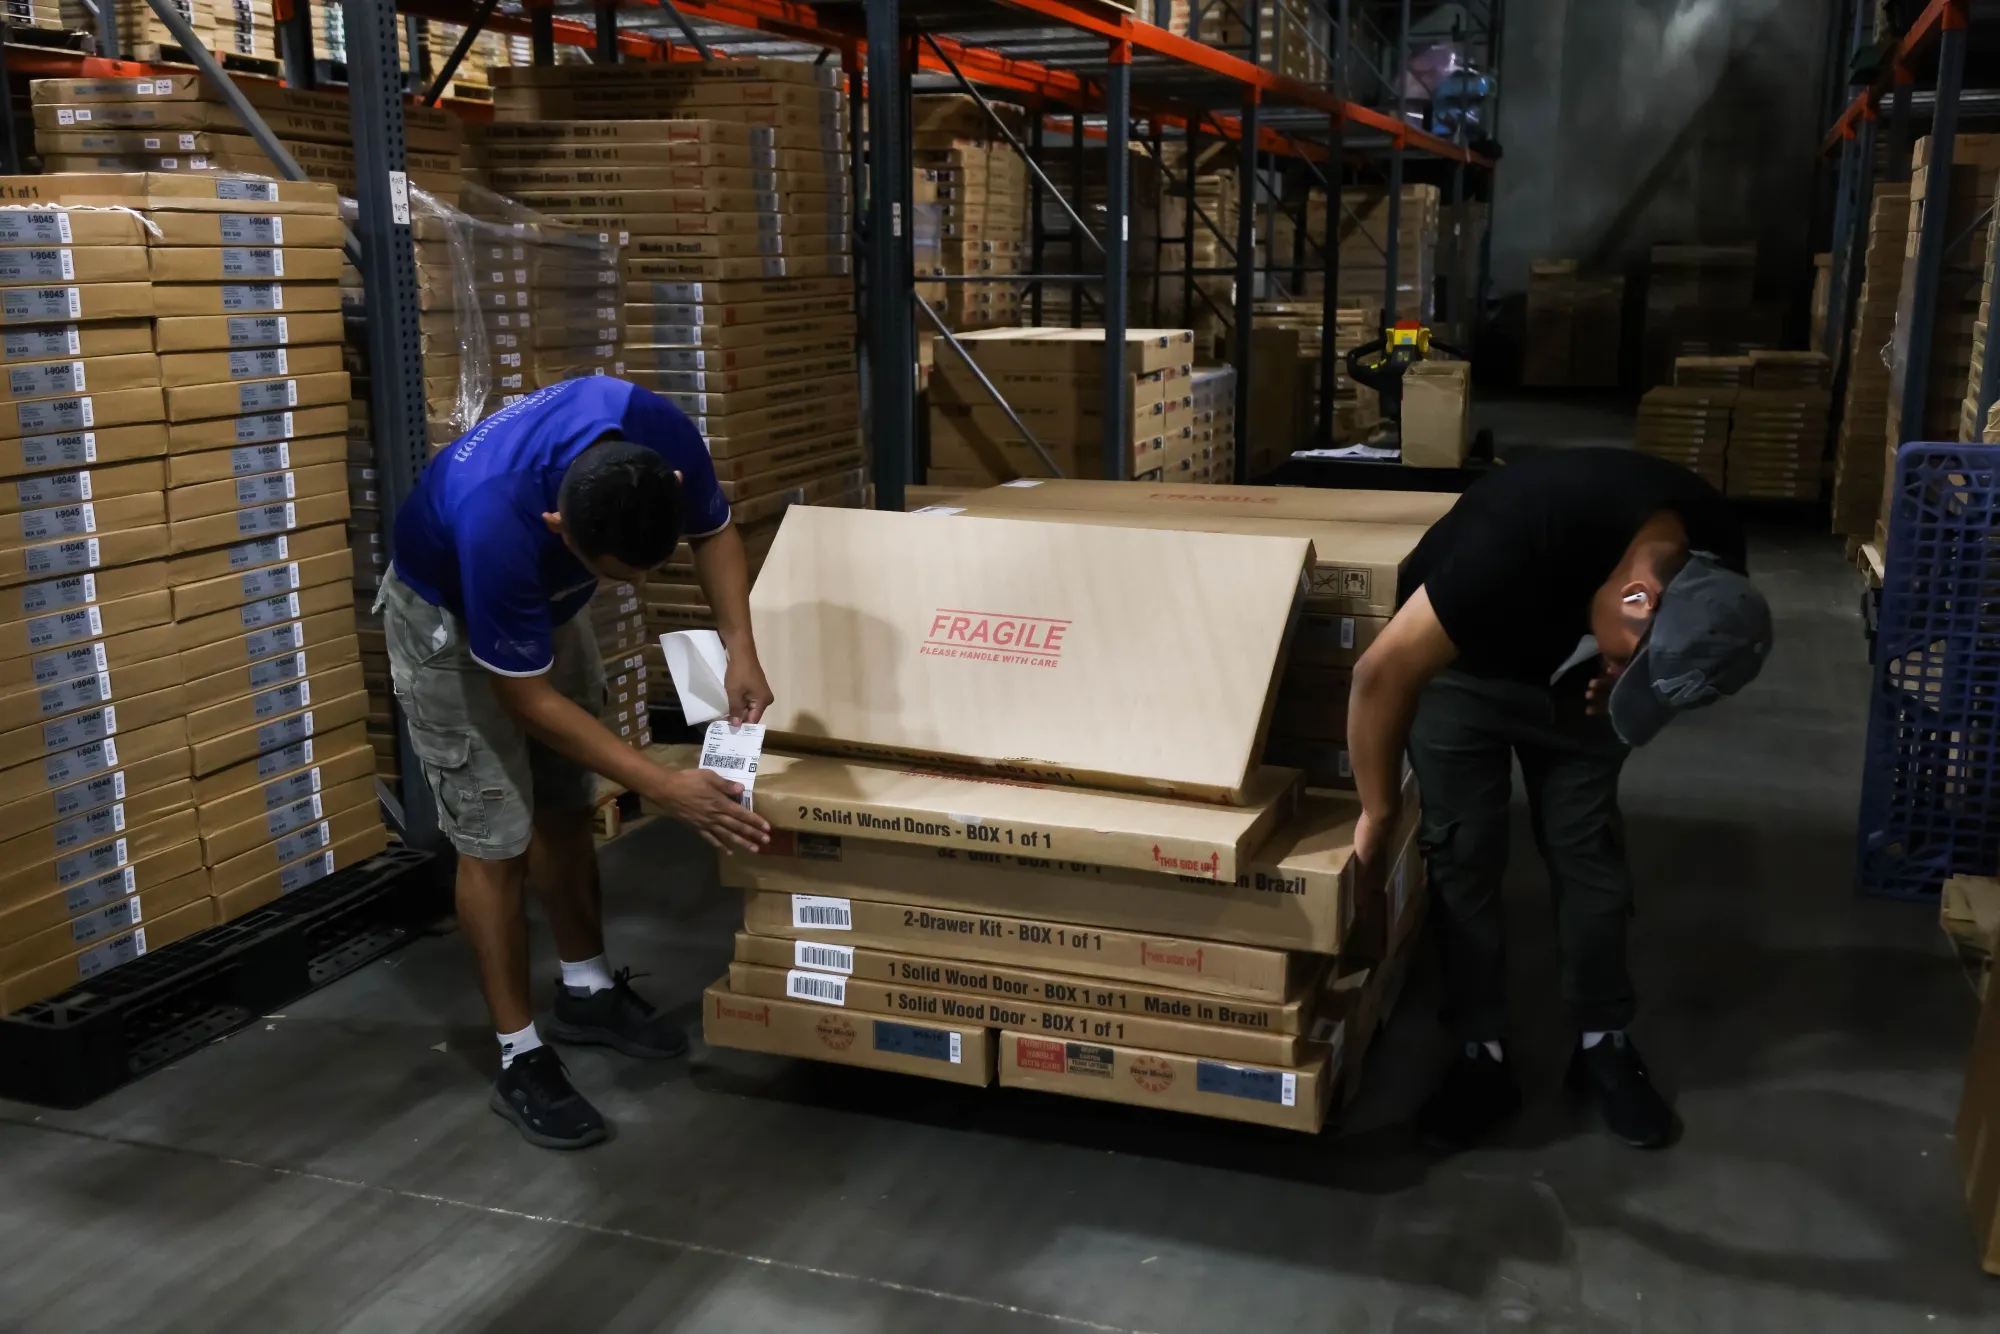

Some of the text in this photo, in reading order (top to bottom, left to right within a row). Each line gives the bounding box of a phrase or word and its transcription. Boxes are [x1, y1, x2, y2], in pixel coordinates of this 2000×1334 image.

[9, 187, 14, 197] 1
[33, 186, 39, 198] 1
[28, 215, 54, 223] I-9045
[30, 252, 57, 260] I-9045
[39, 268, 52, 276] Gray
[38, 291, 65, 299] I-9045
[38, 329, 63, 337] I-9045
[45, 366, 70, 375] I-9045
[53, 402, 78, 411] I-9045
[57, 437, 81, 446] I-9045
[52, 475, 76, 485] I-9045
[55, 508, 80, 518] I-9045
[60, 543, 85, 552] I-9045
[56, 579, 81, 589] I-9045
[61, 611, 85, 623] I-9045
[929, 615, 1066, 650] FRAGILE
[67, 648, 91, 659] I-9045
[920, 646, 1058, 668] PLEASE HANDLE WITH CARE
[72, 677, 96, 689] I-9045
[77, 712, 101, 724] I-9045
[799, 806, 808, 819] 2
[813, 807, 852, 825] Solid
[857, 812, 900, 831] Wood
[904, 818, 950, 836] Doors
[967, 824, 1000, 843] BOX
[1005, 829, 1013, 844] 1
[1021, 832, 1038, 846] of
[1043, 834, 1052, 848] 1
[1159, 857, 1178, 868] THIS
[1179, 859, 1198, 871] SIDE
[1255, 873, 1307, 895] Brazil
[904, 910, 974, 935] 2-Drawer
[980, 920, 1002, 938] Kit
[1019, 924, 1052, 944] BOX
[1057, 931, 1065, 946] 1
[1072, 933, 1088, 949] of
[1093, 935, 1101, 951] 1
[888, 962, 896, 977] 1
[902, 963, 940, 983] Solid
[945, 969, 988, 989] Wood
[992, 975, 1028, 995] Door
[1044, 983, 1076, 1002] BOX
[1082, 989, 1090, 1004] 1
[1097, 990, 1113, 1007] of
[1119, 994, 1127, 1009] 1
[1144, 996, 1191, 1017] Made
[1218, 1005, 1269, 1028] Brazil
[884, 993, 893, 1008] 1
[898, 993, 937, 1014] Solid
[942, 999, 985, 1020] Wood
[989, 1006, 1025, 1026] Door
[1042, 1012, 1075, 1033] BOX
[1080, 1018, 1087, 1034] 1
[1094, 1020, 1111, 1037] of
[1116, 1023, 1124, 1040] 1
